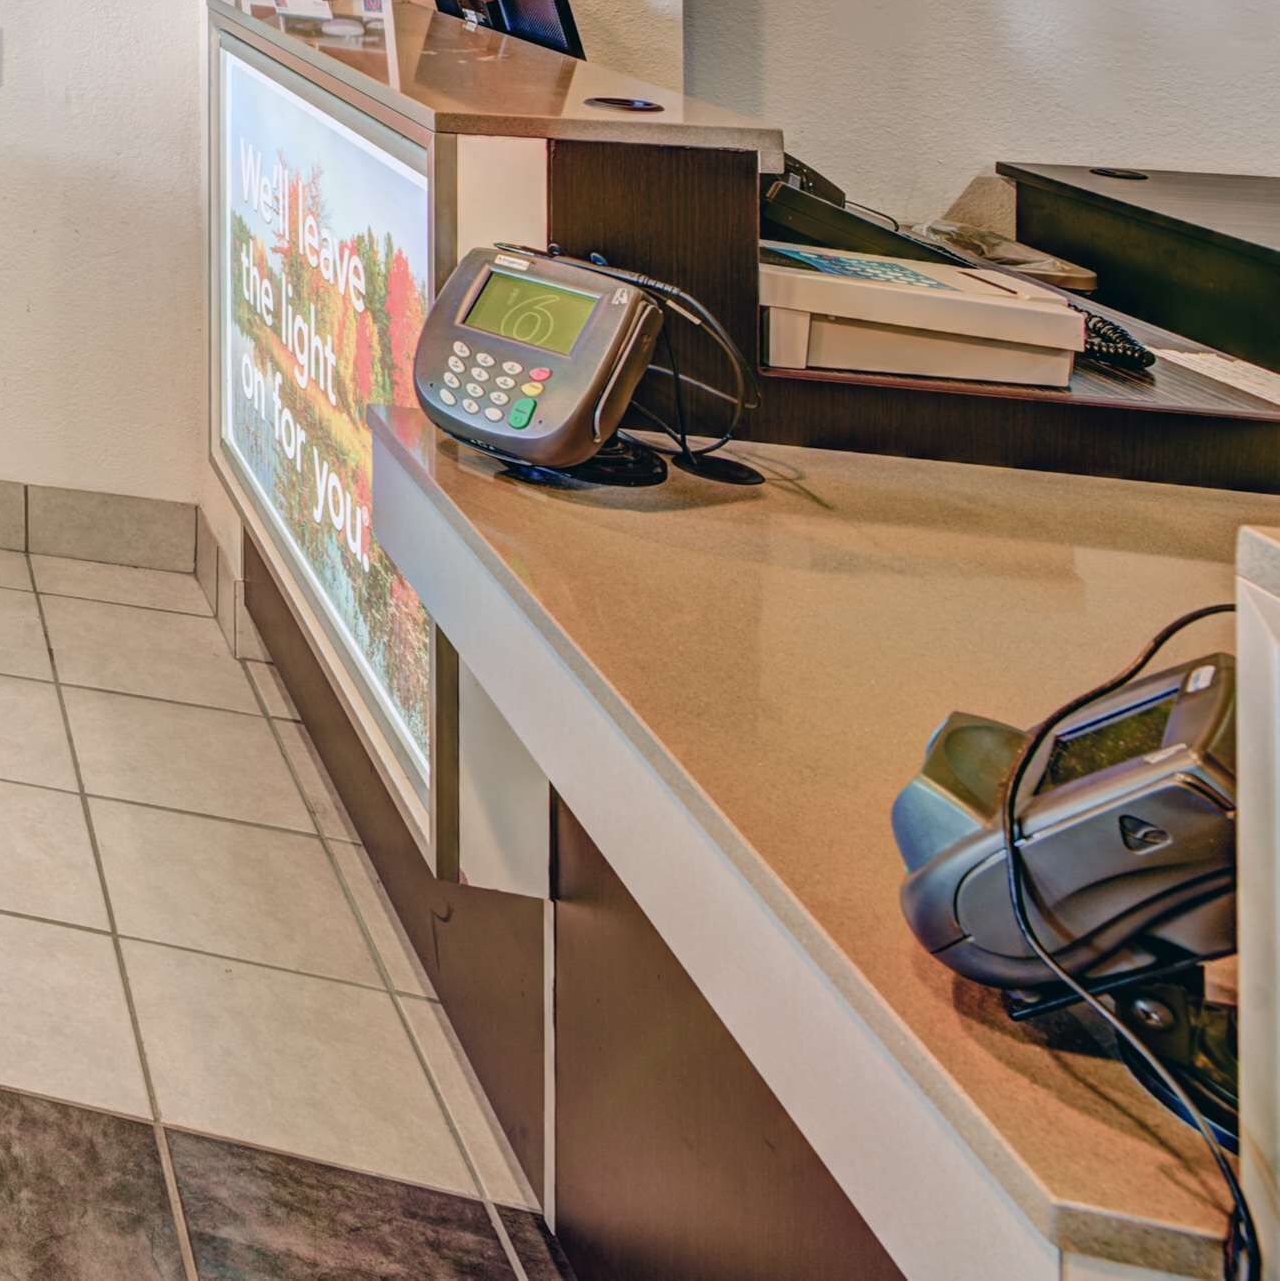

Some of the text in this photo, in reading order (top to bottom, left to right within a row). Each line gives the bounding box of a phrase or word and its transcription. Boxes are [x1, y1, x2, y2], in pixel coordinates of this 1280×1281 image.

[241, 136, 366, 313] We'll leave
[241, 239, 337, 407] the light
[241, 353, 265, 419] on
[273, 371, 305, 473] for
